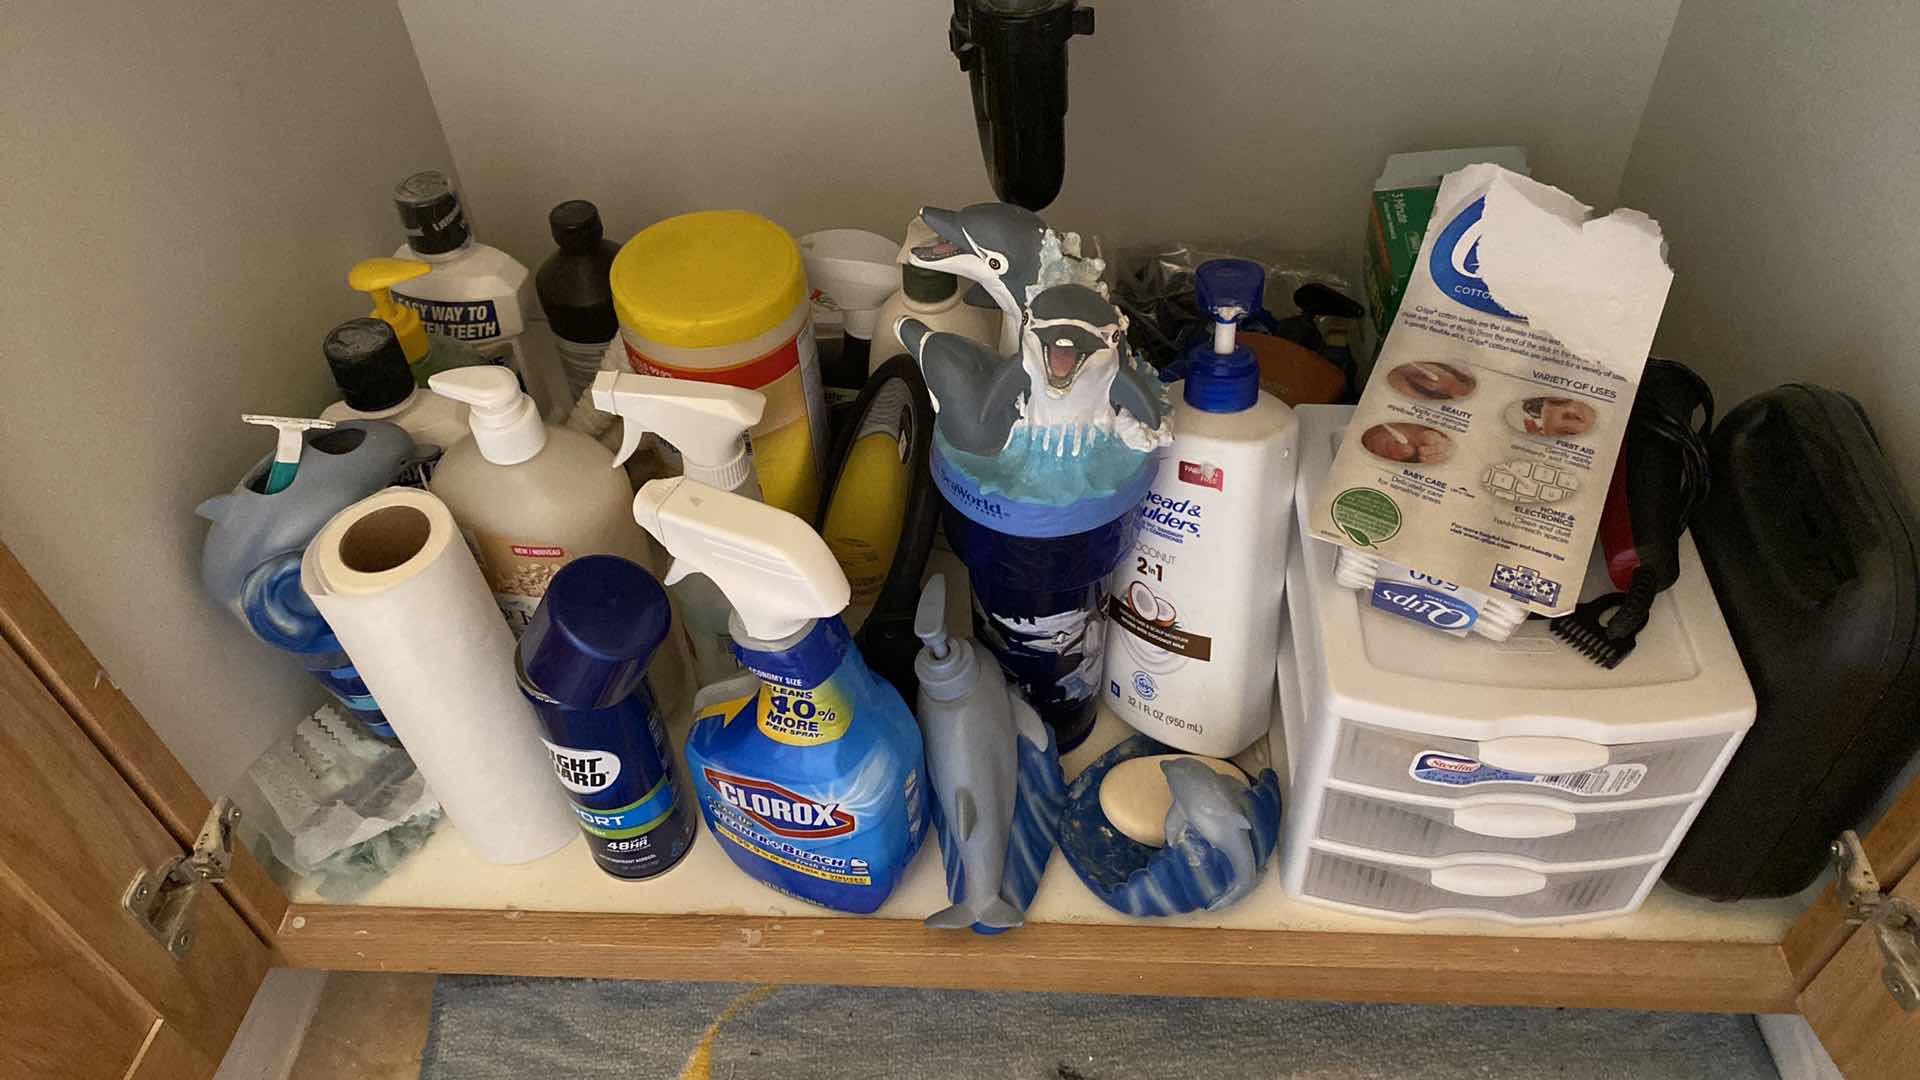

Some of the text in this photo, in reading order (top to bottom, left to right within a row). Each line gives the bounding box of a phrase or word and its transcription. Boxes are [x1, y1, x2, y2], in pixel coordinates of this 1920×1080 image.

[1455, 285, 1491, 300] COTTO
[432, 305, 464, 321] WAY
[468, 305, 488, 320] TO
[450, 322, 496, 340] TEETH
[1532, 368, 1617, 399] VARIETY OF USES
[1440, 405, 1473, 419] BEAUTY
[1555, 440, 1595, 455] FIRST AID
[1402, 468, 1448, 489] BABY CARE
[1187, 505, 1201, 518] &
[1513, 506, 1574, 528] ELECTRONICS
[1540, 506, 1567, 518] HOME
[1135, 541, 1176, 565] OCONUT
[1136, 556, 1163, 582] 2in1
[785, 676, 802, 687] SIZE
[765, 721, 787, 733] PER
[767, 709, 819, 732] MORE
[1152, 709, 1164, 721] OZ
[1165, 714, 1185, 728] (950
[550, 749, 603, 773] IGHT
[718, 780, 839, 827] CLOROX
[576, 809, 625, 826] ORT
[708, 804, 770, 846] CLEANER
[781, 842, 846, 868] BLEACH
